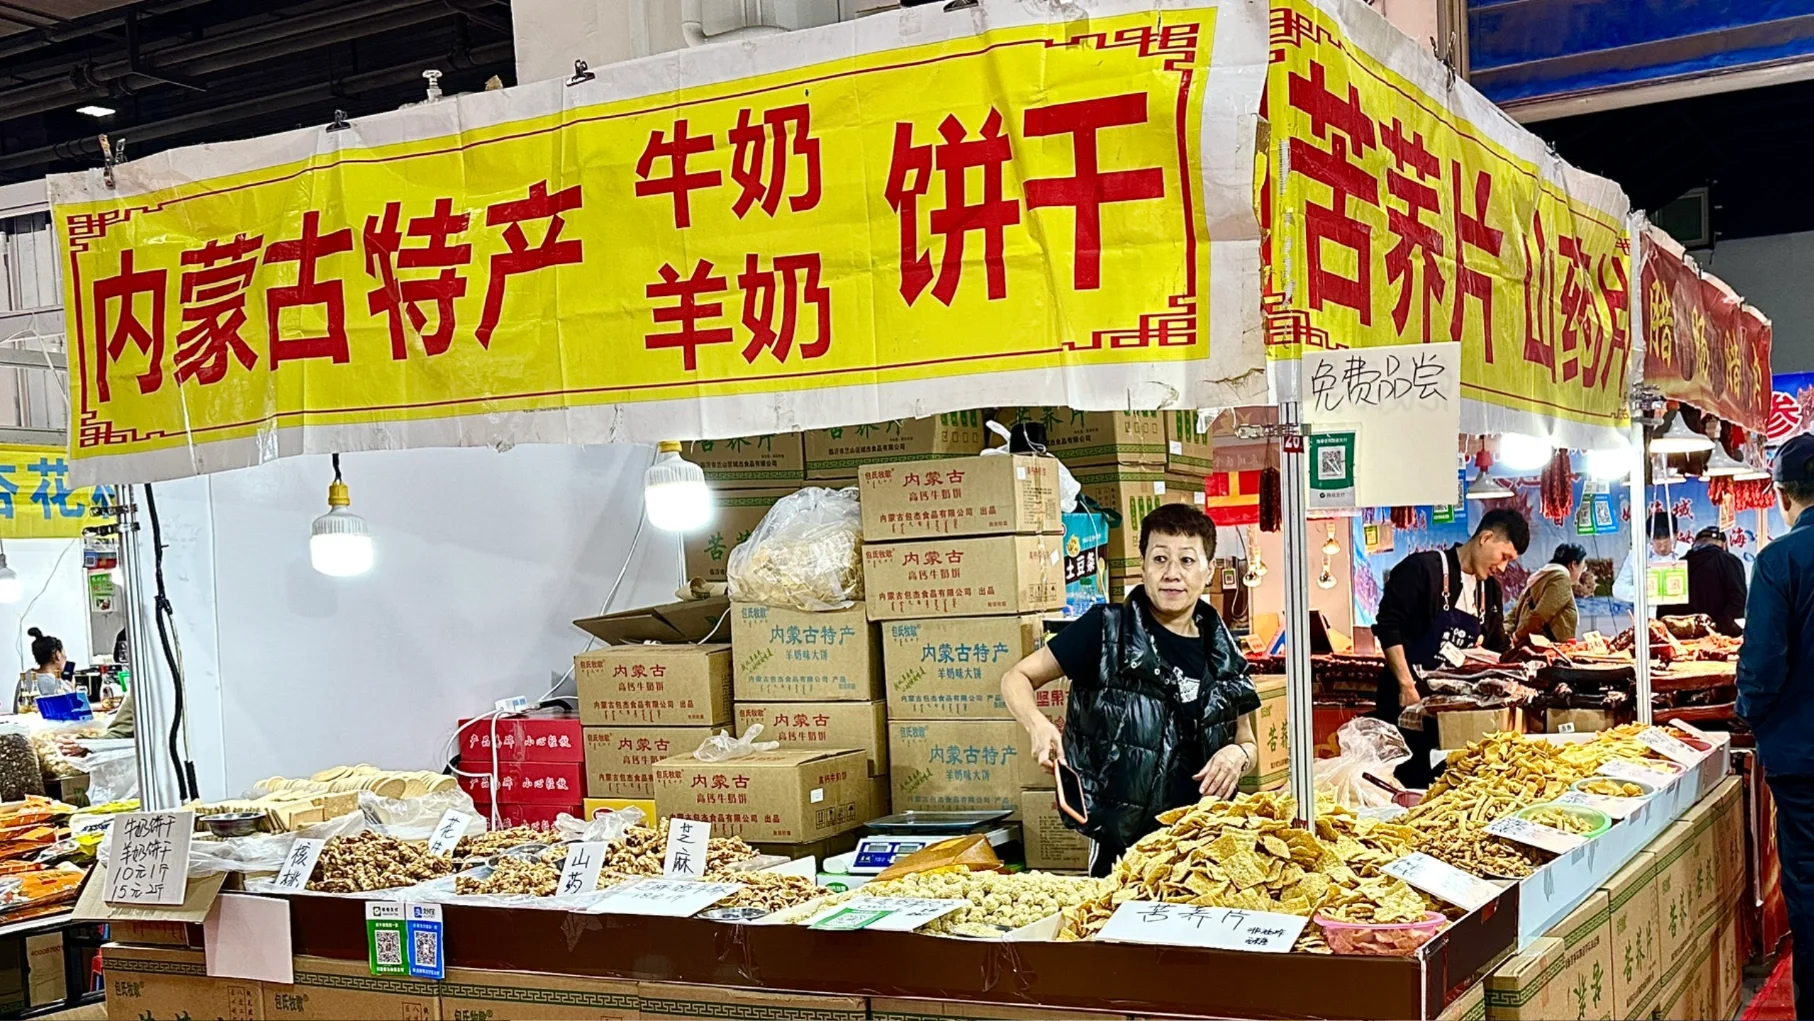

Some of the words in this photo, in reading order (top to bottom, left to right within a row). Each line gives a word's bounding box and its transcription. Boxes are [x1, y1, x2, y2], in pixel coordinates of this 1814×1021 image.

[635, 103, 822, 229] 牛奶
[884, 91, 1166, 307] 饼干
[93, 180, 582, 402] 内蒙古特产
[644, 252, 831, 371] 羊奶
[1311, 352, 1448, 411] 免费品尝
[903, 469, 965, 487] 内蒙古
[908, 488, 962, 502] 高钙牛奶饼
[902, 550, 964, 566] 内蒙古
[908, 568, 960, 580] 高钙牛奶饼
[769, 624, 856, 645] 内蒙古特产
[920, 642, 1009, 663] 内蒙古特产
[612, 664, 667, 678] 内蒙古
[1036, 690, 1070, 707] 坚果
[773, 713, 830, 727] 内蒙古
[617, 738, 670, 751] 内蒙古
[929, 745, 1018, 765] 内蒙古特产
[691, 774, 750, 789] 内蒙古
[696, 793, 747, 804] 高钙牛奶饼
[124, 815, 176, 840] 牛奶饼干
[120, 839, 172, 865] 羊奶饼干
[672, 822, 696, 874] 芝麻
[563, 848, 590, 894] 山药
